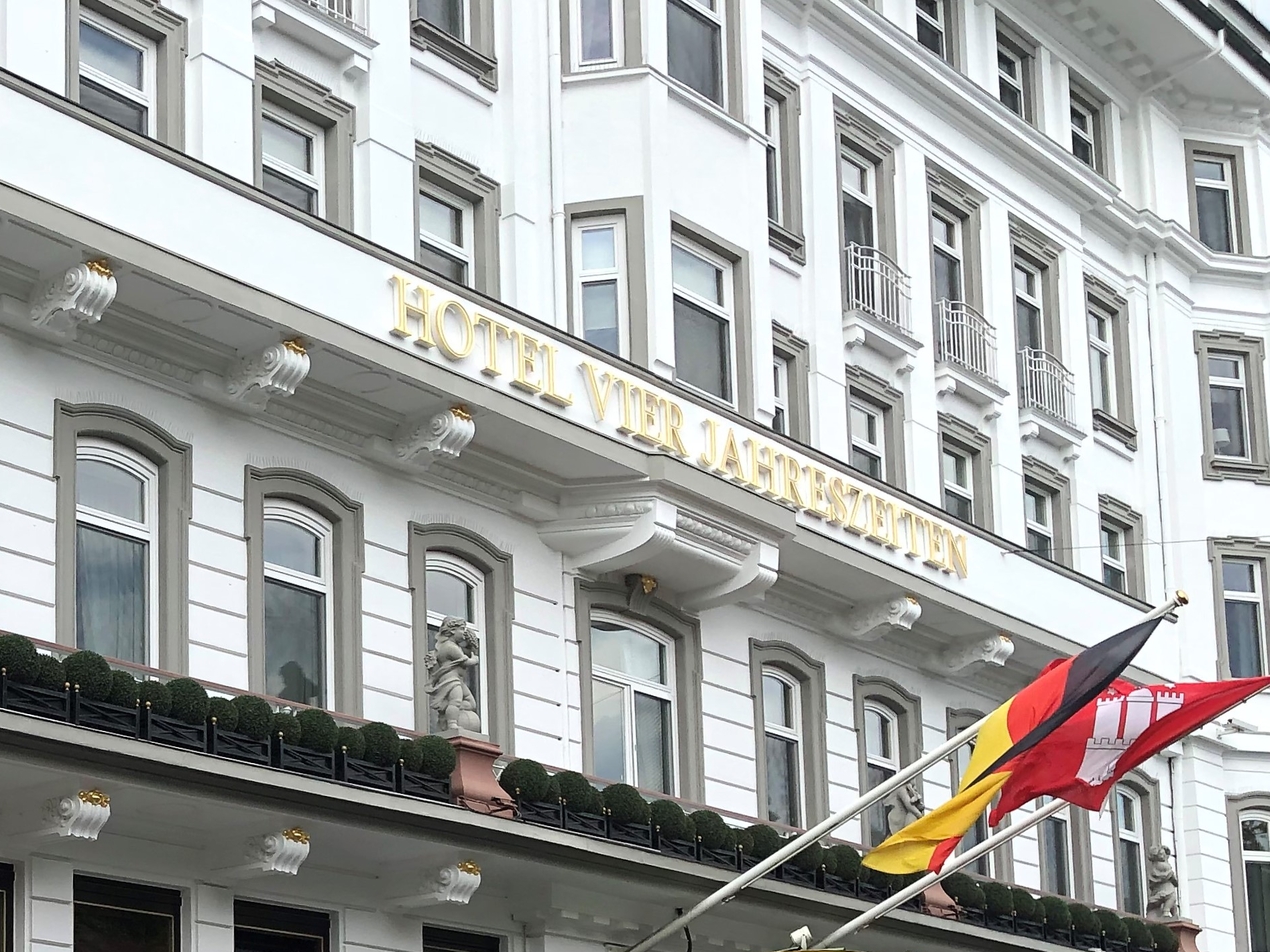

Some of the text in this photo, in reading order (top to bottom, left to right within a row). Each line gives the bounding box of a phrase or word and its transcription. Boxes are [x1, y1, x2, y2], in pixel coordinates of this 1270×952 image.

[388, 274, 969, 579] HOTEL VIER JAHRESZEITEN
